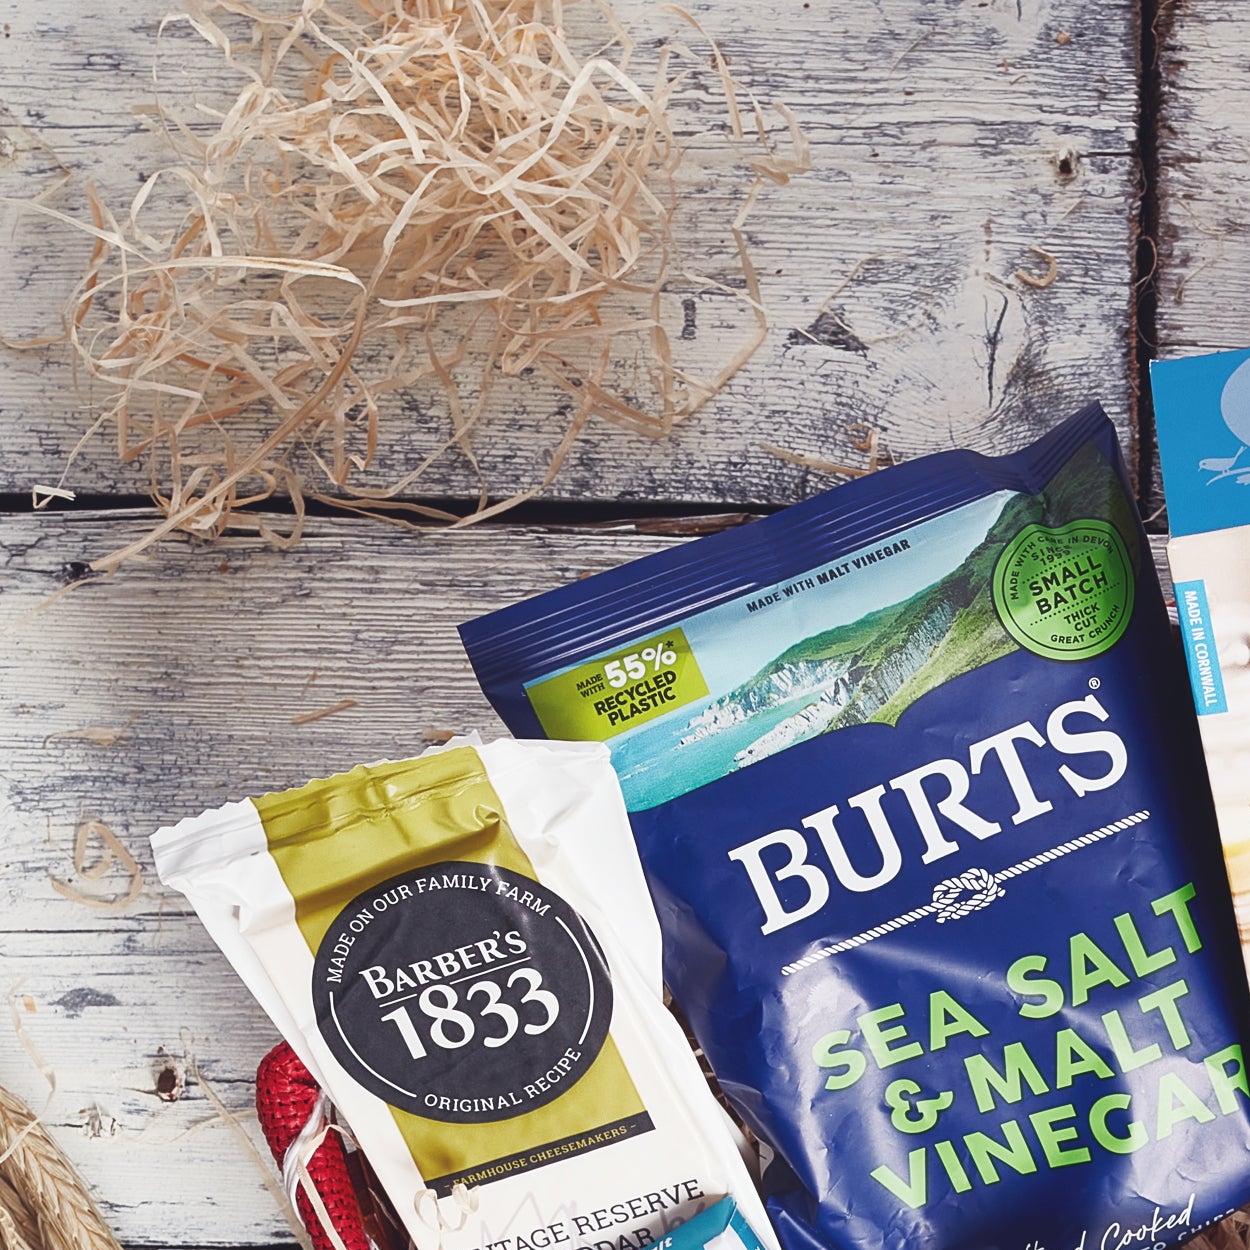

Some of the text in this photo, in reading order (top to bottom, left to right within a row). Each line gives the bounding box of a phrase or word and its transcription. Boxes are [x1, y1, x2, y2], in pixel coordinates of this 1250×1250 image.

[1014, 541, 1036, 568] WITH
[1039, 549, 1071, 567] 1999
[1068, 535, 1079, 544] IN
[1082, 535, 1114, 555] DEVON
[745, 538, 912, 613] MADE WITH MALT VINEGAR
[1010, 570, 1020, 600] MADE
[1028, 555, 1103, 597] SMALL
[1035, 570, 1109, 616] BATCH
[1050, 603, 1121, 645] GREAT CRUNCH
[1063, 602, 1101, 625] THICK
[1074, 615, 1098, 632] CUT
[1184, 590, 1218, 708] MADE IN CORNWALL
[575, 673, 603, 691] MADE
[580, 682, 606, 699] WITH
[593, 670, 677, 716] RECYCLED
[607, 687, 677, 727] PLASTIC
[727, 693, 1128, 936] BURTS
[326, 874, 552, 984] MADE ON OUR FAMILY FARM
[811, 881, 1204, 1092] SEA SALT
[380, 967, 560, 1060] 1833
[883, 978, 1193, 1135] & MALT
[424, 1047, 582, 1113] ORIGINAL RECIPE
[451, 1124, 628, 1188] FARMHOUSE CHEESEMAKERS
[571, 1177, 706, 1237] RESERVE
